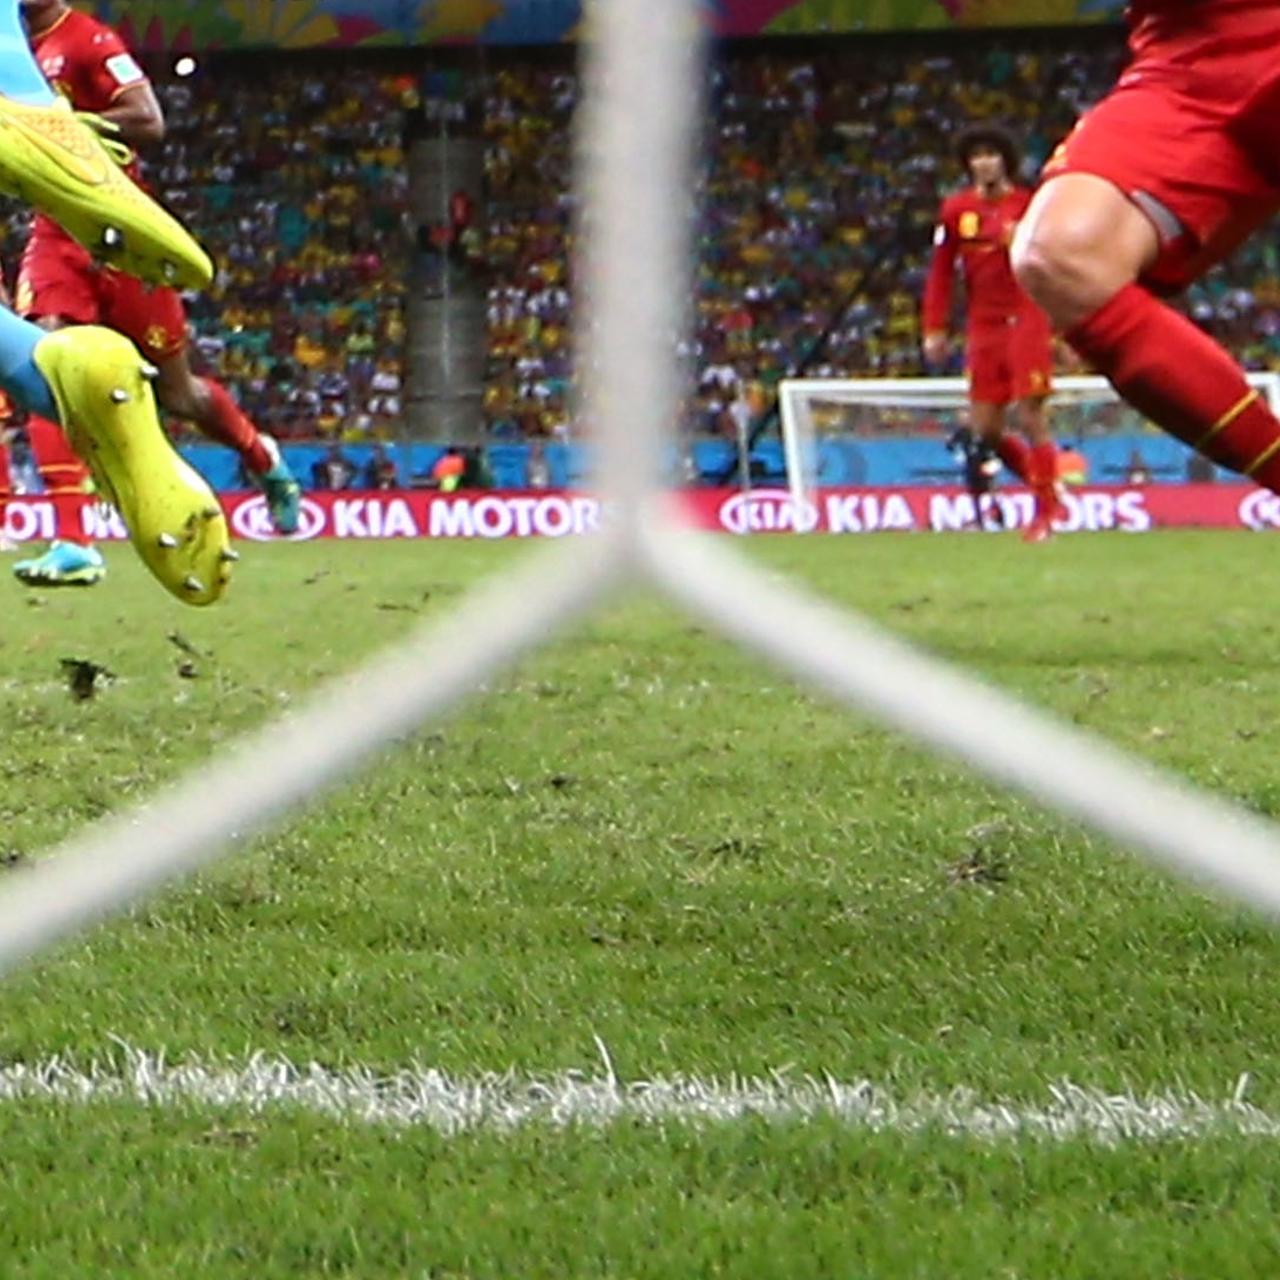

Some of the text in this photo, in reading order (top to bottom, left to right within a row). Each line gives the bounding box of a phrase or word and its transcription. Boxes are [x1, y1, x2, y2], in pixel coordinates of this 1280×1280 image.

[333, 498, 417, 538] KIA
[428, 497, 602, 538] MOTOR
[825, 494, 914, 533] KIA
